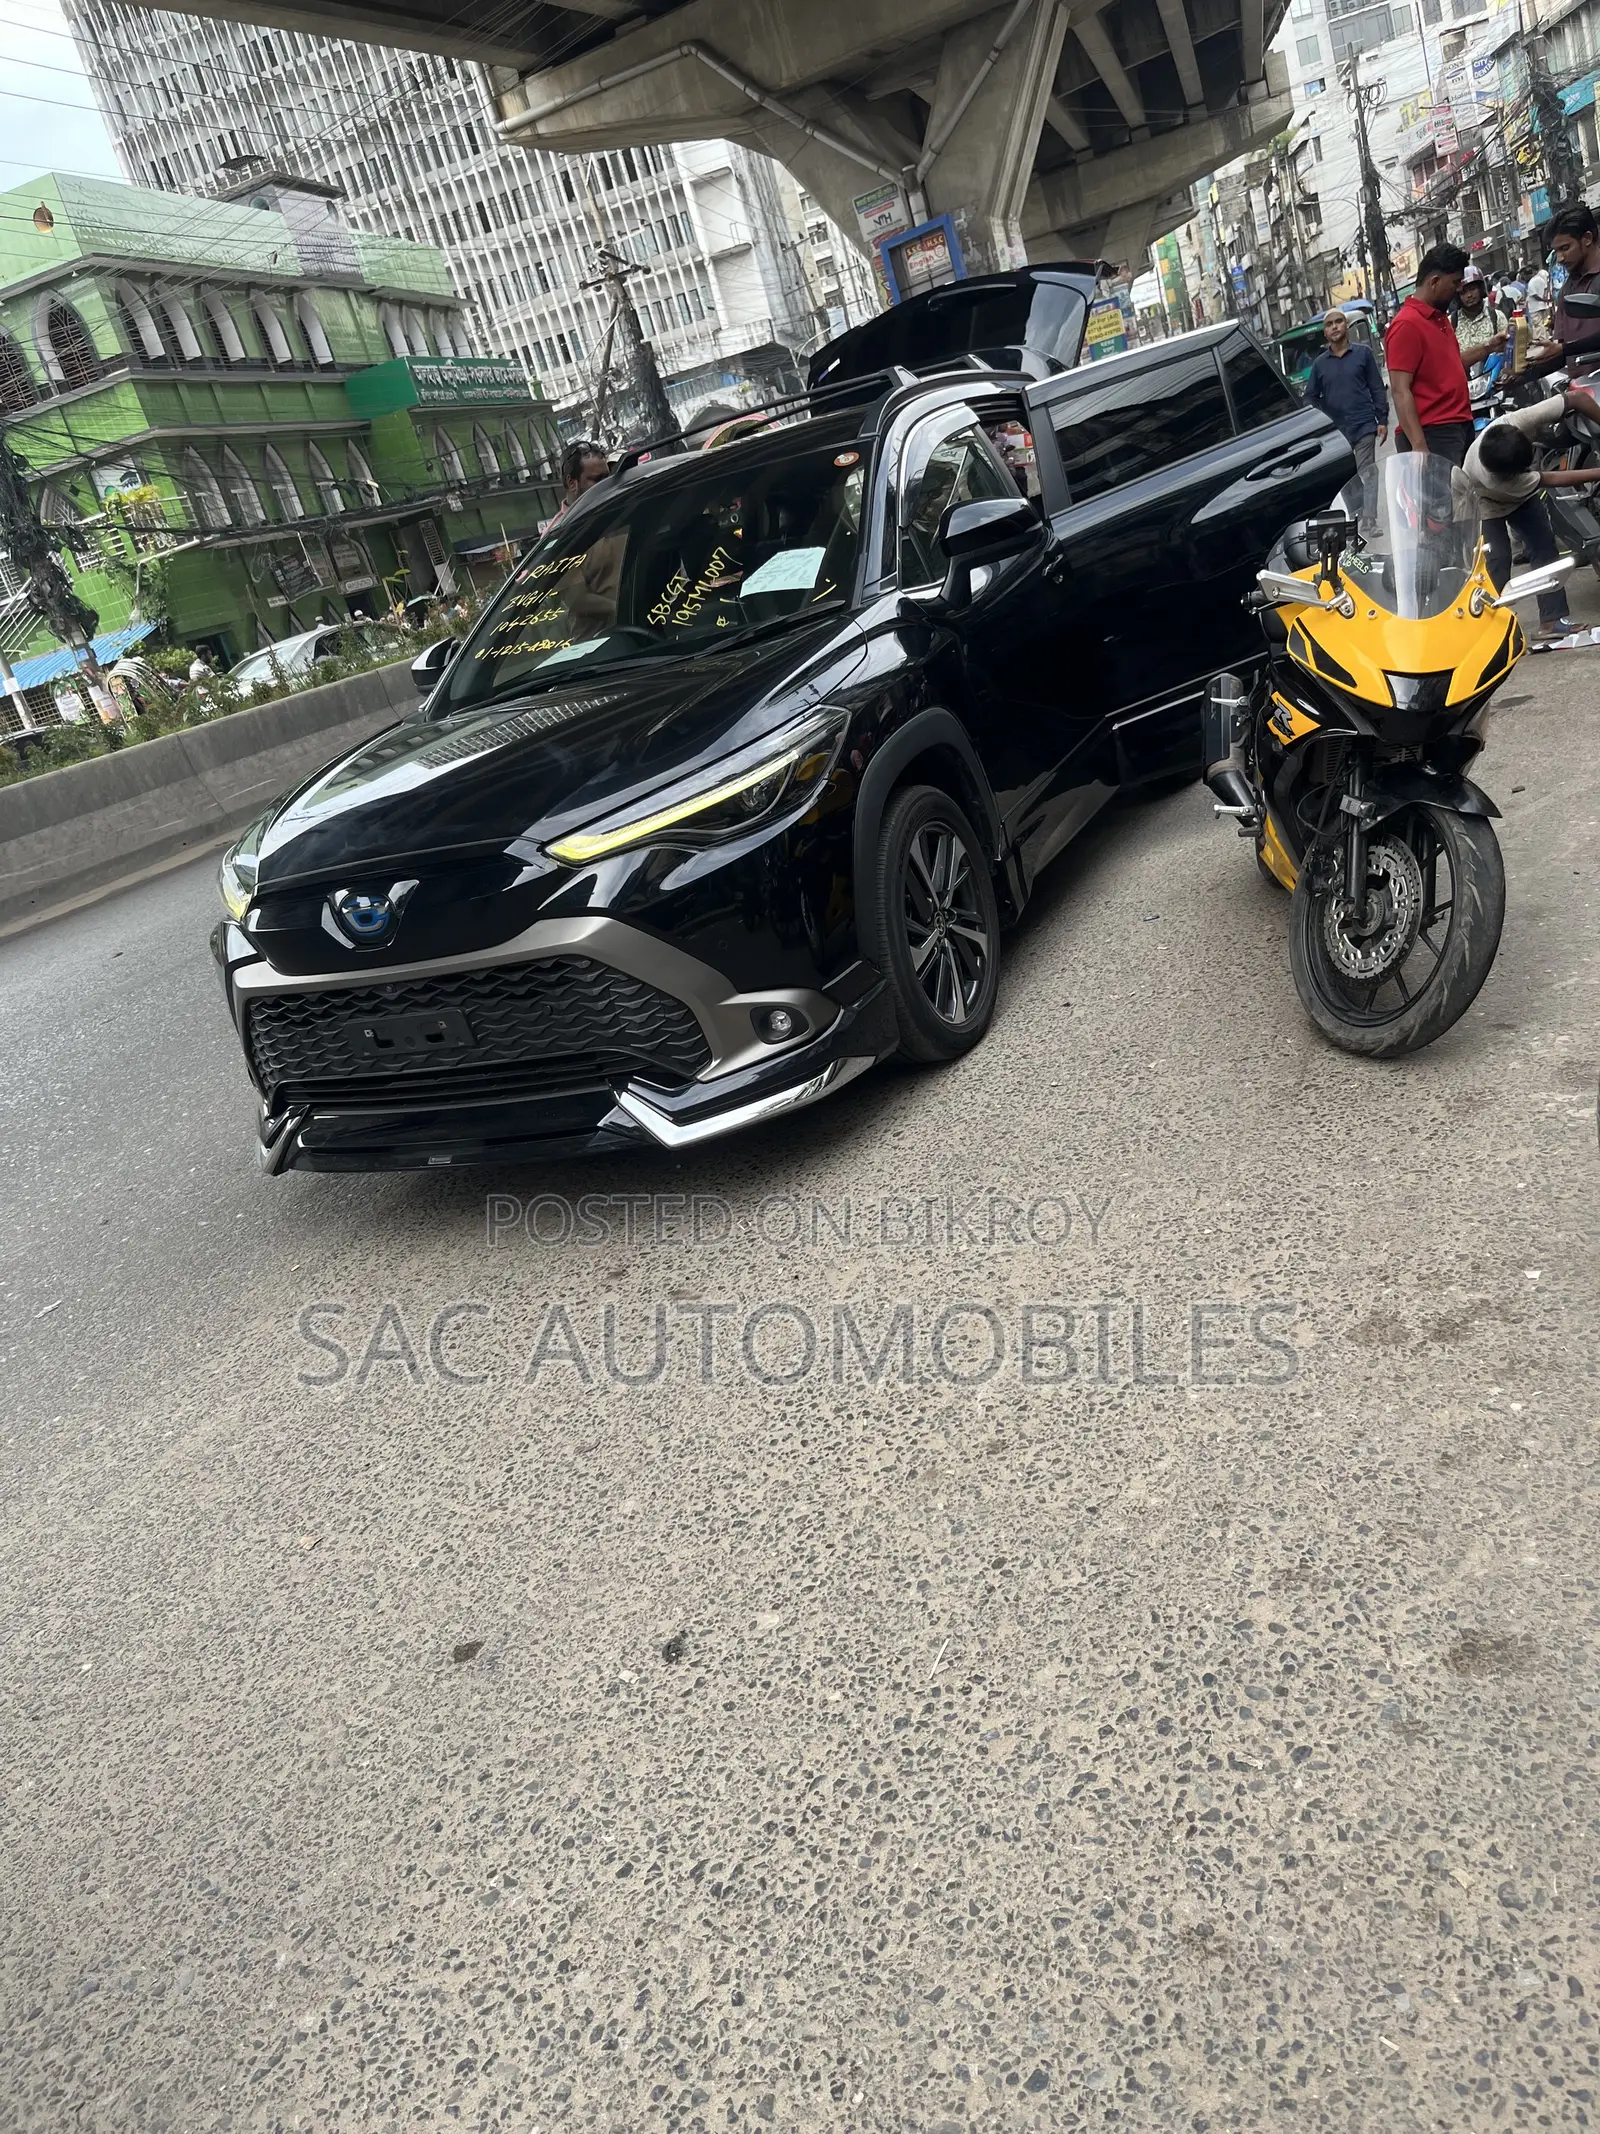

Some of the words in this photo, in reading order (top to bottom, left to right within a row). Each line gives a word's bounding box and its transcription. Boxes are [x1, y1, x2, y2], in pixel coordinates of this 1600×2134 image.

[1442, 60, 1465, 71] SONY
[1473, 57, 1489, 68] CITY
[1474, 59, 1494, 79] DENTAL
[909, 254, 935, 270] English
